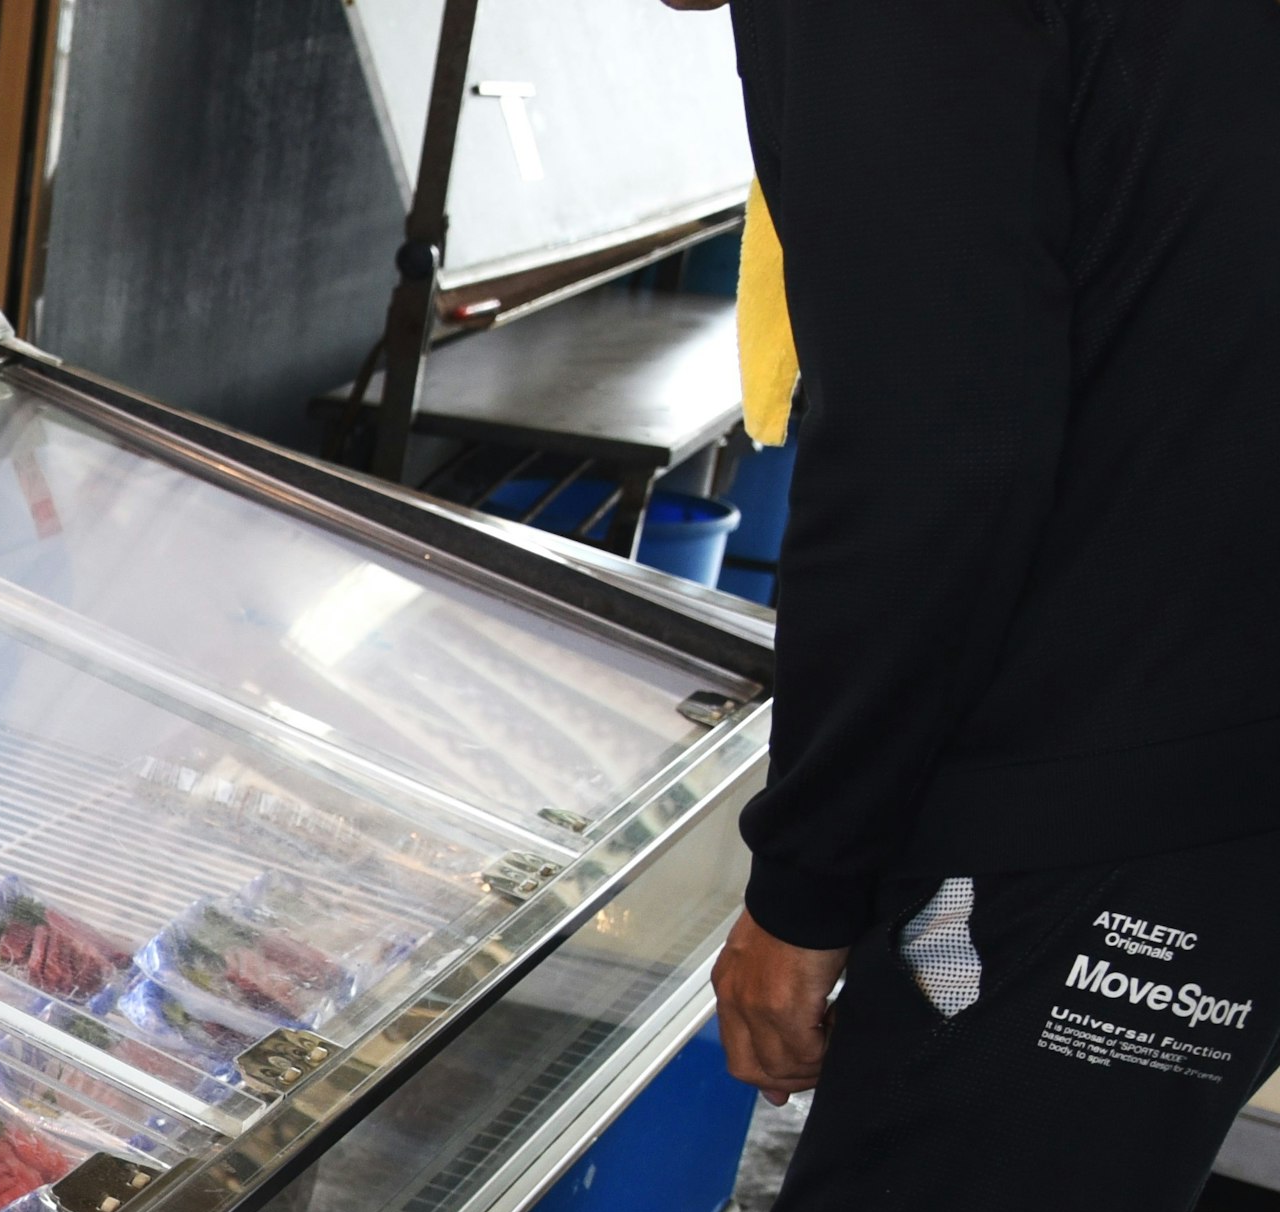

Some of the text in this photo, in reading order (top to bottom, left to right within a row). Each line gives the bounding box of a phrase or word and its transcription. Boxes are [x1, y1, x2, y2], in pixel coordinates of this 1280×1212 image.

[1093, 910, 1198, 951] ATHLETIC
[1104, 931, 1175, 963] Originals
[1037, 1038, 1048, 1048] to
[1075, 1050, 1087, 1060] to
[1041, 1030, 1072, 1046] based
[1072, 1039, 1086, 1049] on
[1087, 1044, 1109, 1056] new
[1109, 1047, 1149, 1068] functional
[1050, 1005, 1232, 1063] Universal Function
[1054, 1021, 1063, 1033] is
[1063, 1026, 1105, 1045] proposal
